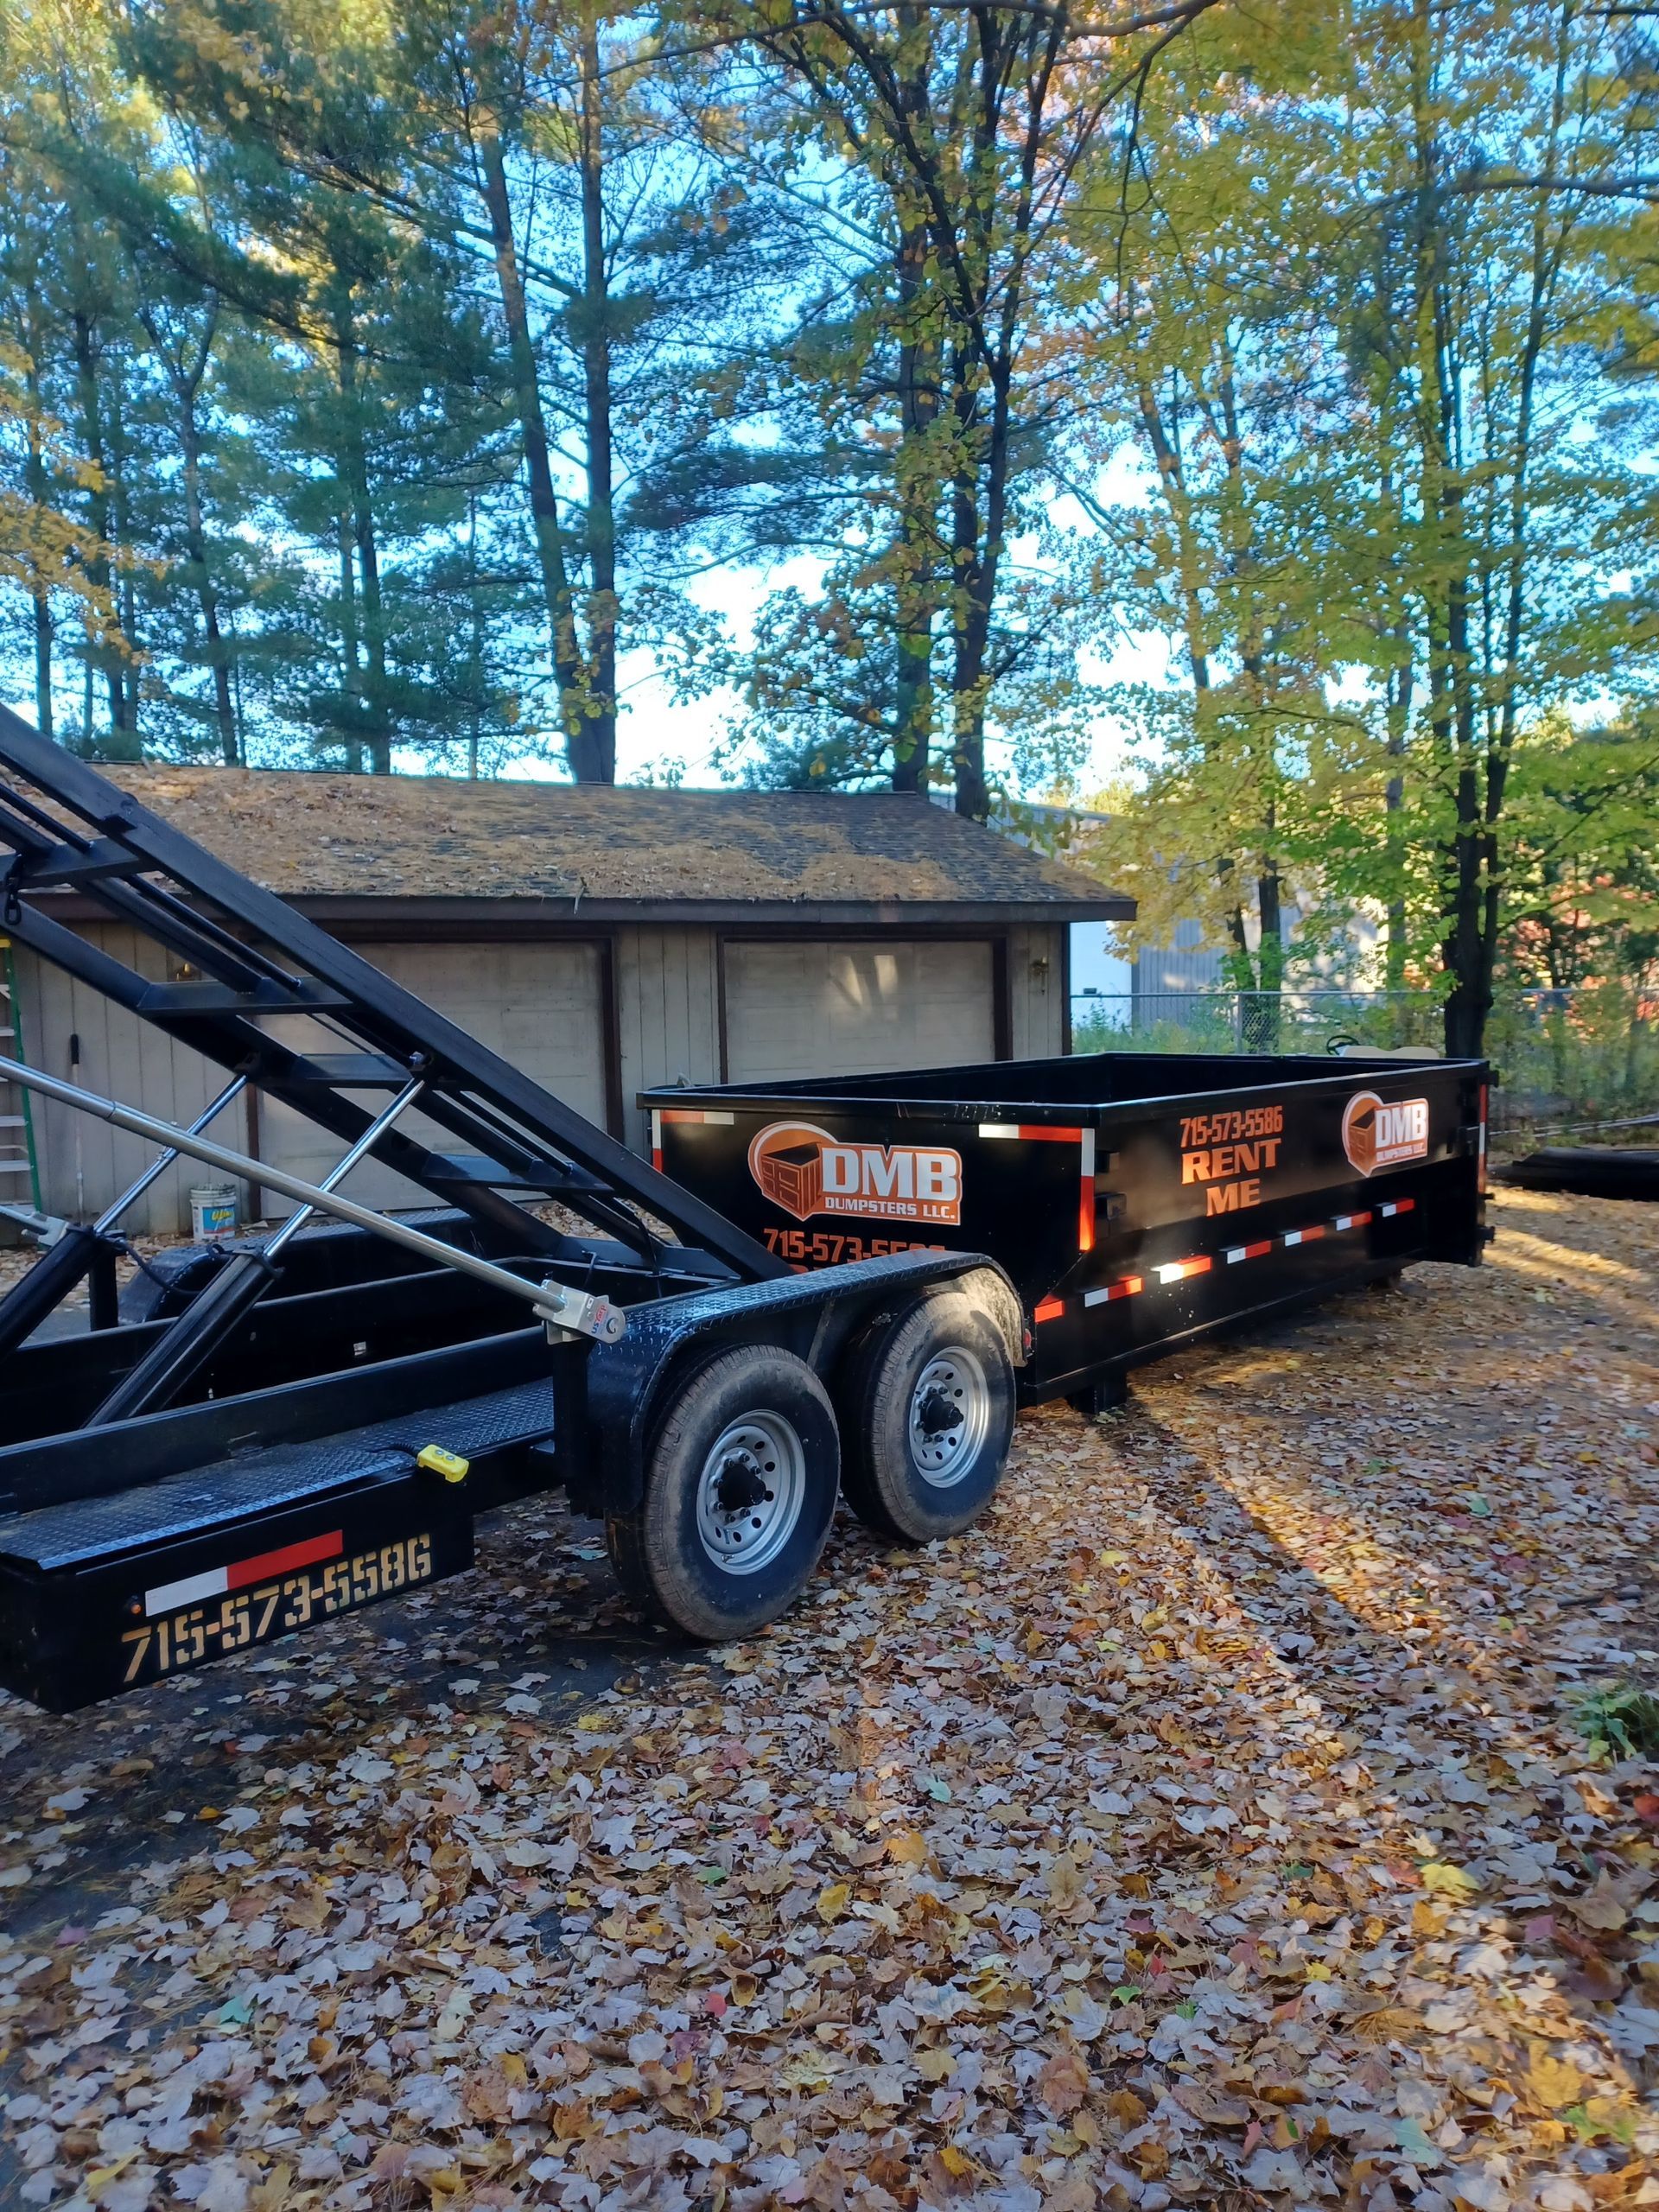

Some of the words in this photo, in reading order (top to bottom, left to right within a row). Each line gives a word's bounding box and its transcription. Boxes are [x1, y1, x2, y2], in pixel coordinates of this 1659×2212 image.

[1180, 1106, 1283, 1148] 715-573-5586
[1375, 1103, 1427, 1148] DMB
[822, 1147, 957, 1201] DMB
[1182, 1138, 1281, 1185] RENT
[824, 1197, 918, 1216] DUMPSTERS
[923, 1205, 955, 1219] LLC.
[1206, 1178, 1261, 1217] ME
[763, 1228, 946, 1263] 715-573-5
[121, 1533, 432, 1682] 715-573-5586
